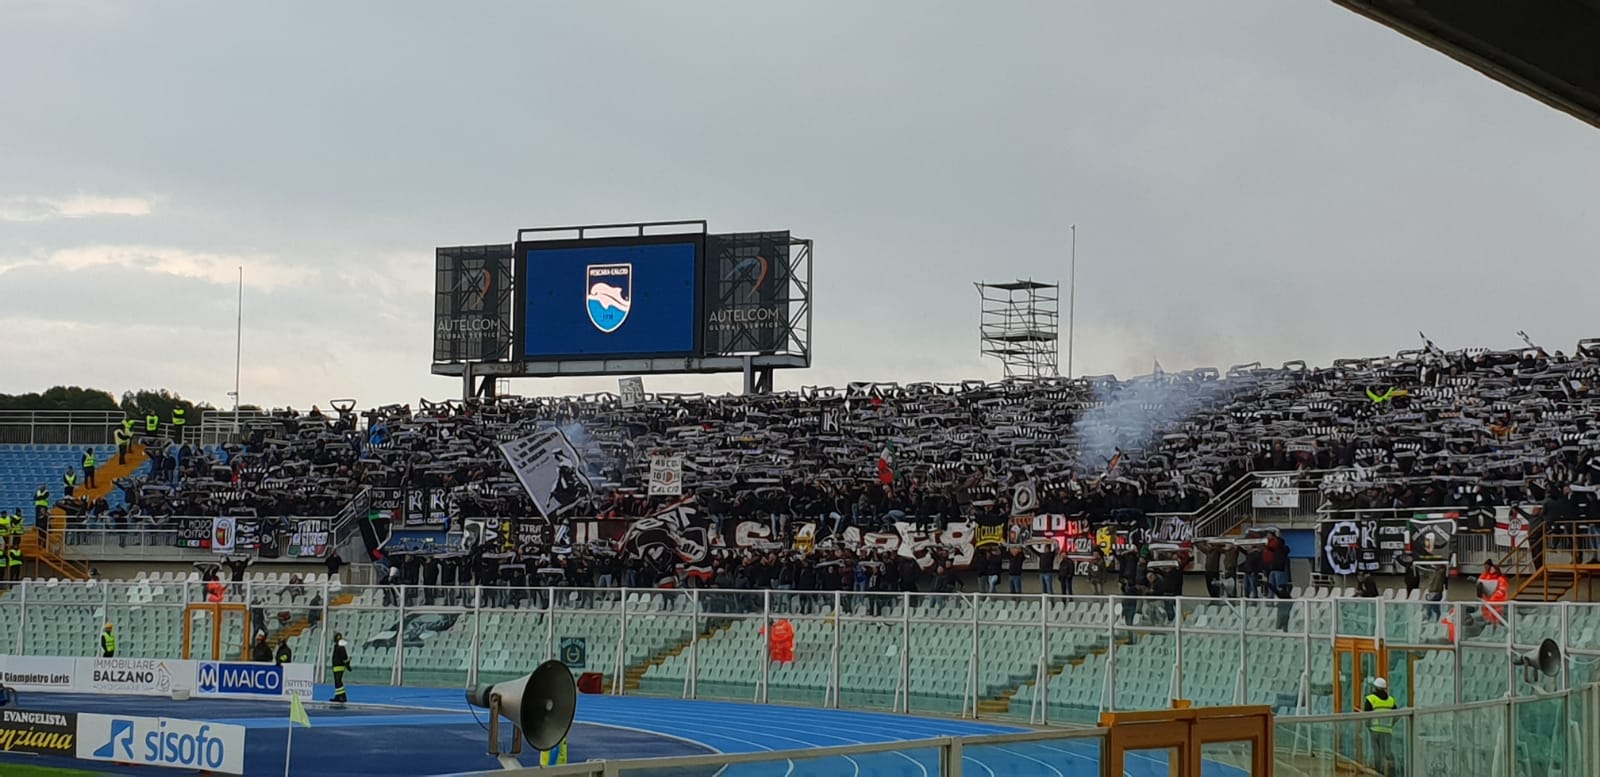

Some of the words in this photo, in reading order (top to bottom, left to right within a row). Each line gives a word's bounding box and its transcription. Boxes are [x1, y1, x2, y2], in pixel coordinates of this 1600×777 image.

[709, 307, 779, 322] AUTELCOM
[438, 318, 501, 331] AUTELCOM
[95, 659, 155, 670] IMMOBILIARE
[50, 673, 70, 683] Loris
[93, 670, 154, 683] BALZANO
[223, 669, 279, 690] MAICO
[4, 711, 67, 726] EVANGELISTA
[145, 721, 224, 769] sisofo
